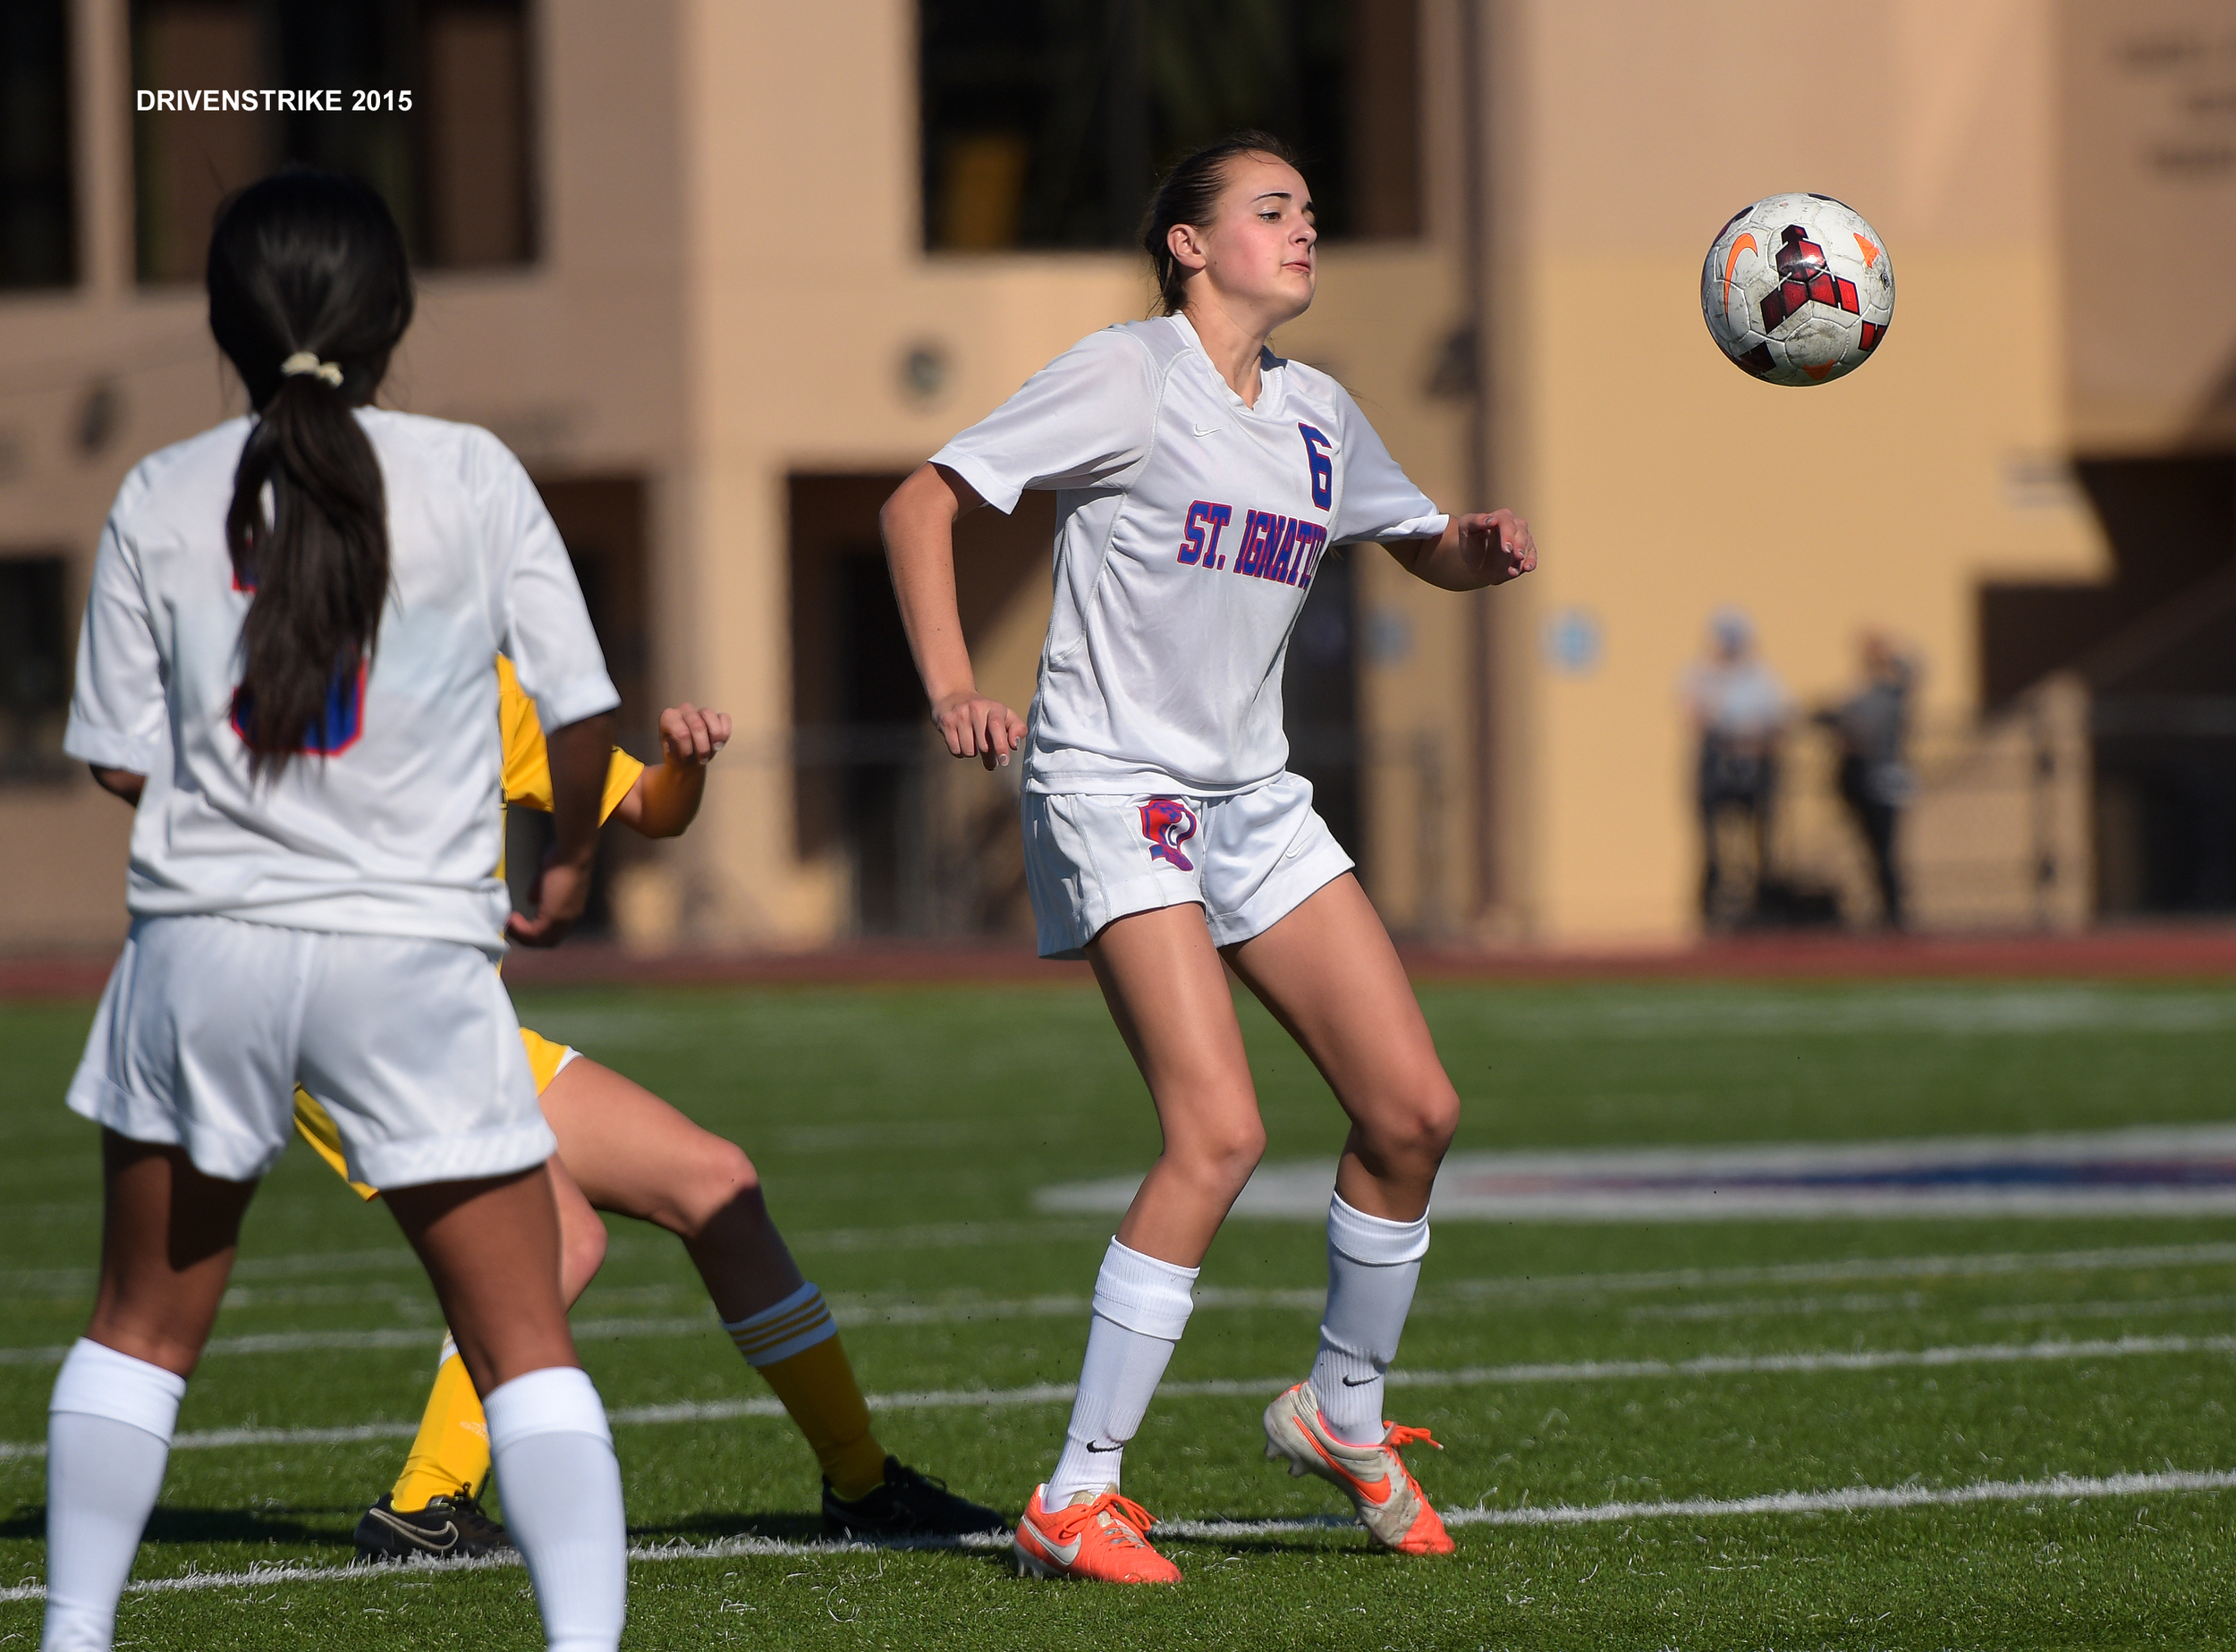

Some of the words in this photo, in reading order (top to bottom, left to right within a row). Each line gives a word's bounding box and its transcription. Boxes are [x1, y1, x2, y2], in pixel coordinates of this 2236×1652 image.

[1298, 421, 1333, 512] 6
[1176, 500, 1232, 570] ST.
[1233, 509, 1327, 590] IGNATI
